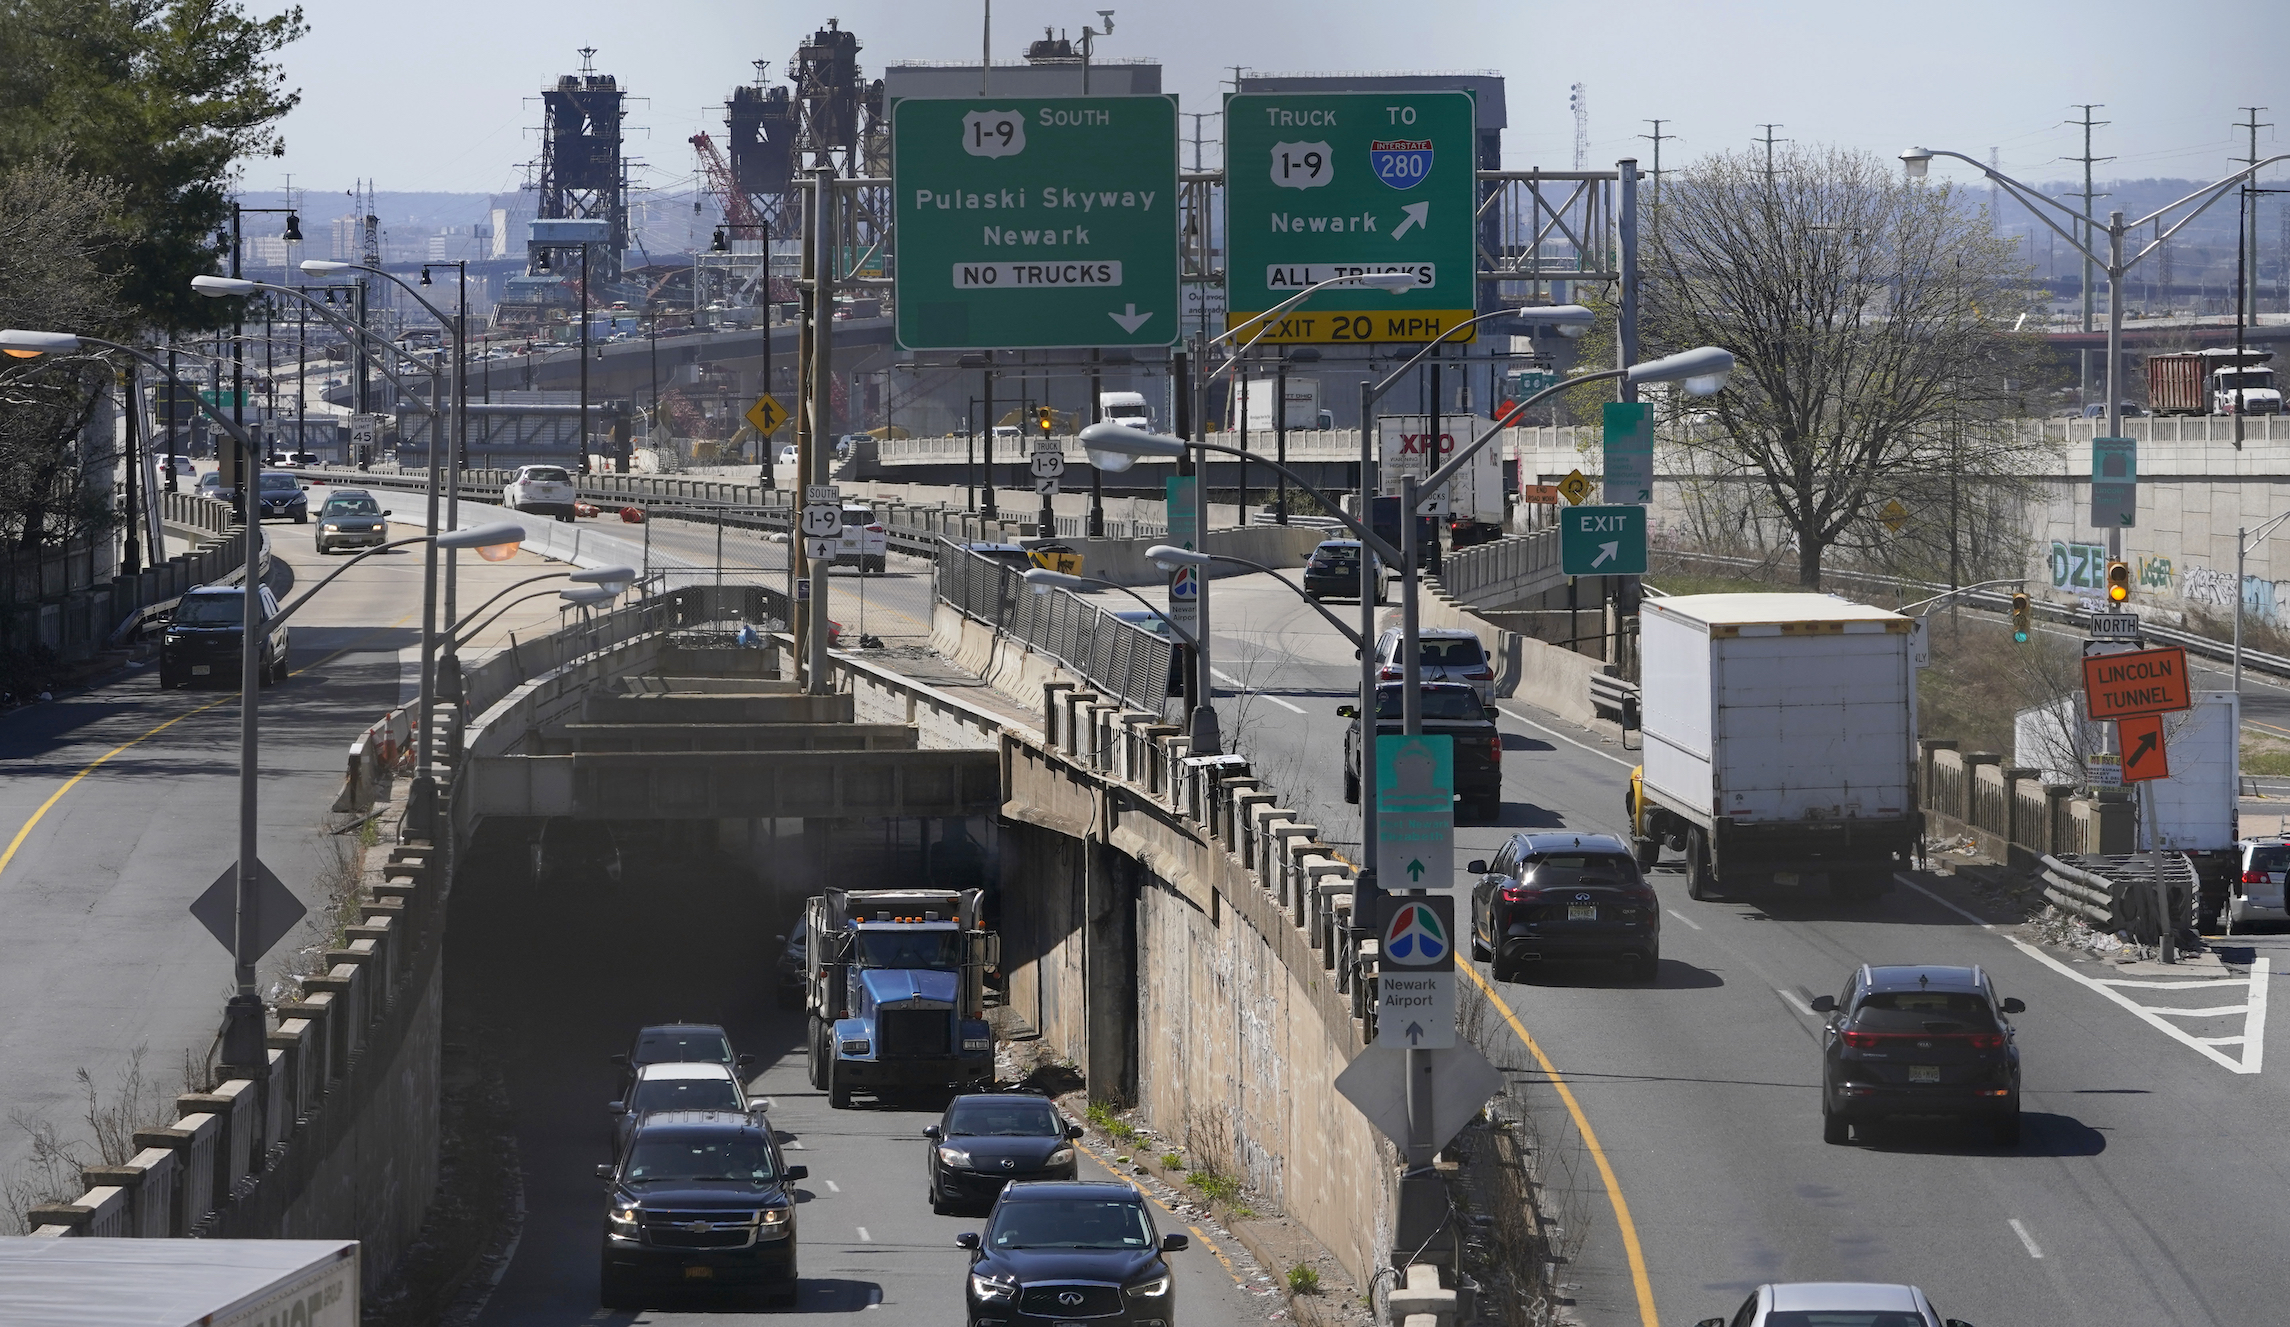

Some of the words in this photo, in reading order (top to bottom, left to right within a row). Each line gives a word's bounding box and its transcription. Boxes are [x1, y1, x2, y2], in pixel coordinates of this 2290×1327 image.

[1039, 107, 1110, 127] SOUTH
[1266, 107, 1337, 127] TRUCK
[1386, 106, 1417, 126] TO
[973, 120, 1014, 148] 1-9
[1376, 142, 1427, 150] INTERSTATE
[1281, 151, 1322, 179] 1-9
[1381, 154, 1423, 178] 280
[916, 187, 1026, 210] Pulaski
[1042, 186, 1156, 213] Skyway
[1271, 211, 1378, 233] Newark
[983, 224, 1090, 246] Newark
[963, 266, 998, 285] NO
[1012, 264, 1111, 284] TRUCKS
[1270, 267, 1319, 287] ALL
[1331, 315, 1373, 340] 20
[1388, 318, 1440, 337] MPH
[353, 431, 372, 442] 45
[1037, 442, 1058, 450] TRUCK
[1400, 433, 1455, 455] XPO
[1036, 457, 1058, 472] 1-9
[809, 487, 837, 498] SOUTH
[808, 511, 836, 529] 1-9
[1580, 515, 1627, 532] EXIT
[2094, 618, 2136, 633] NORTH
[2098, 659, 2172, 684] LINCOLN
[2103, 686, 2173, 708] TUNNEL
[1408, 820, 1449, 828] Newark
[1384, 978, 1436, 990] Newark
[1385, 995, 1433, 1008] Airport
